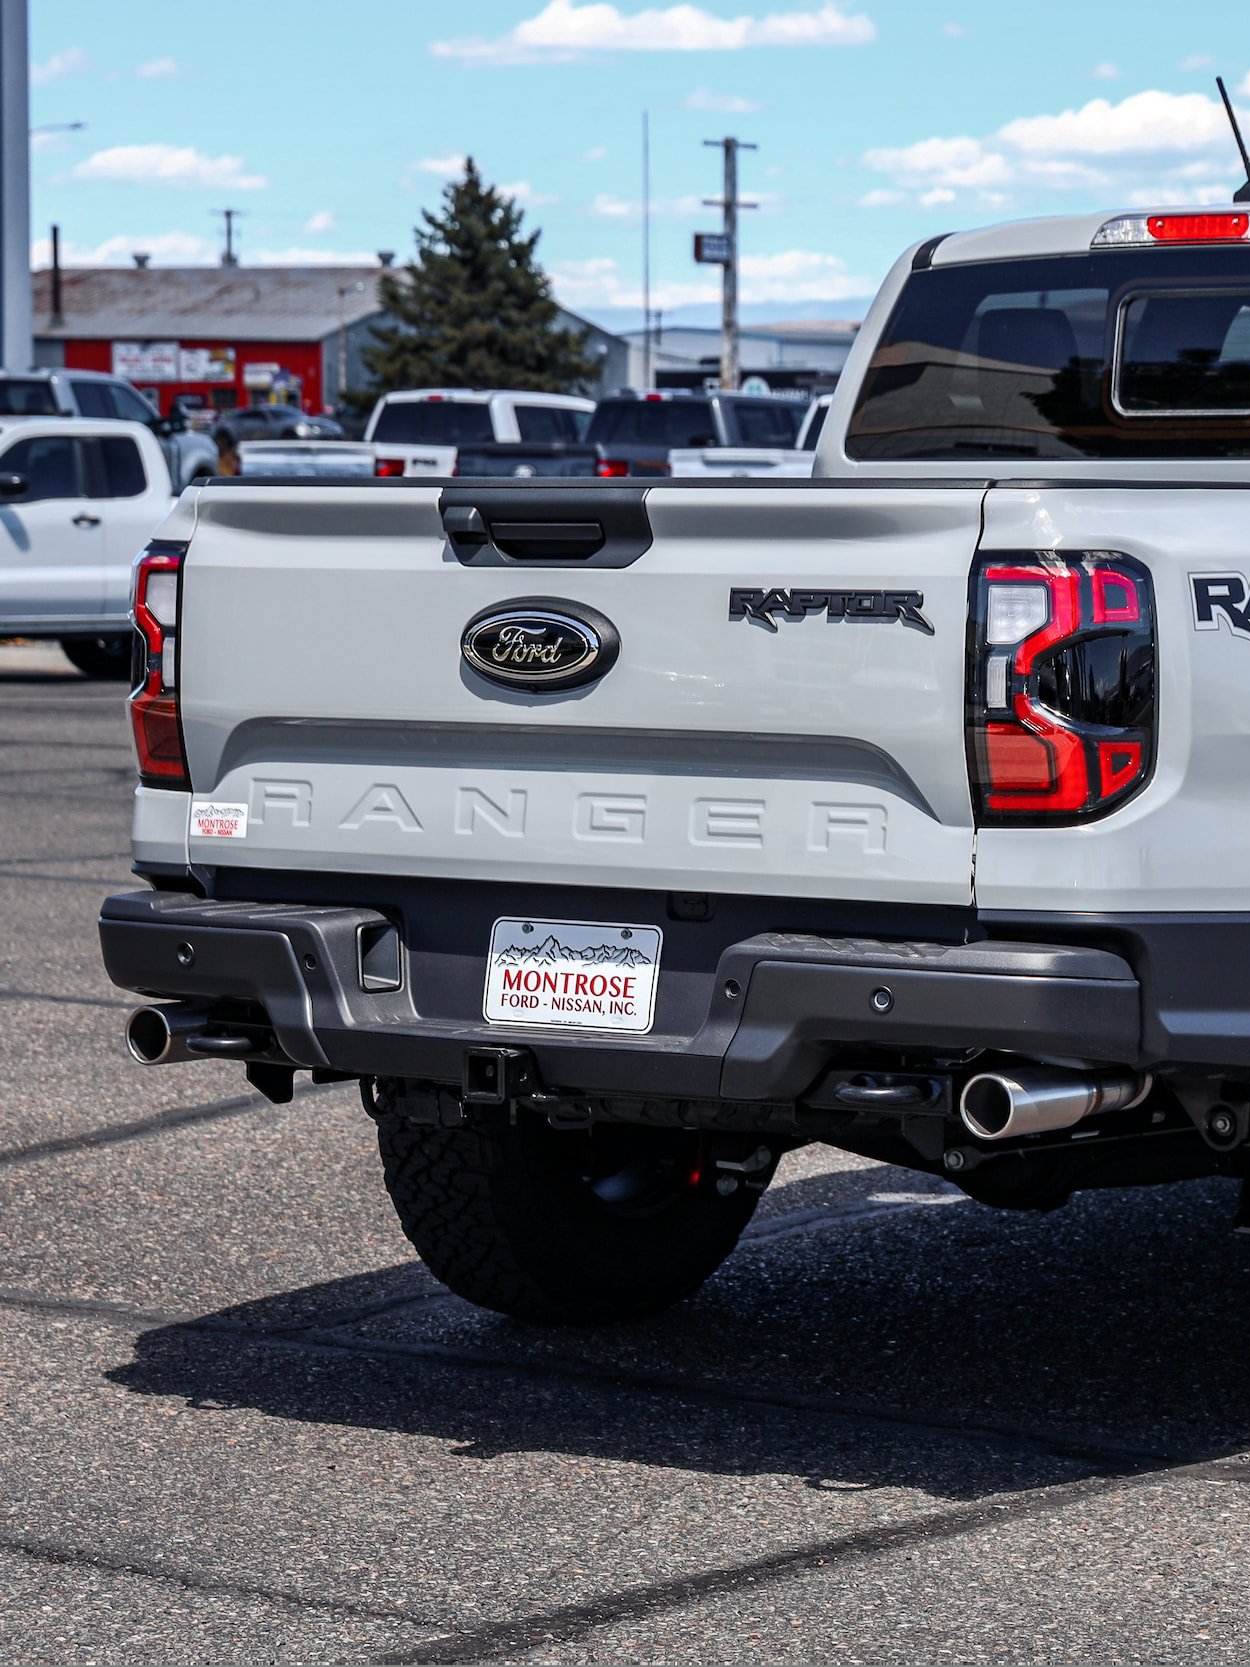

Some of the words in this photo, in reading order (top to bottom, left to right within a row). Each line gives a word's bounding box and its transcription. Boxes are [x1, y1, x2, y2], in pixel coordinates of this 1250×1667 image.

[729, 587, 935, 635] RAPTOR
[491, 625, 562, 665] Ford
[198, 818, 239, 830] MONTROSE
[247, 777, 889, 855] RANGER
[502, 968, 637, 999] MONTROSE
[501, 993, 540, 1009] FORD
[551, 997, 606, 1016] NISSAN,
[609, 1001, 638, 1016] INC.
